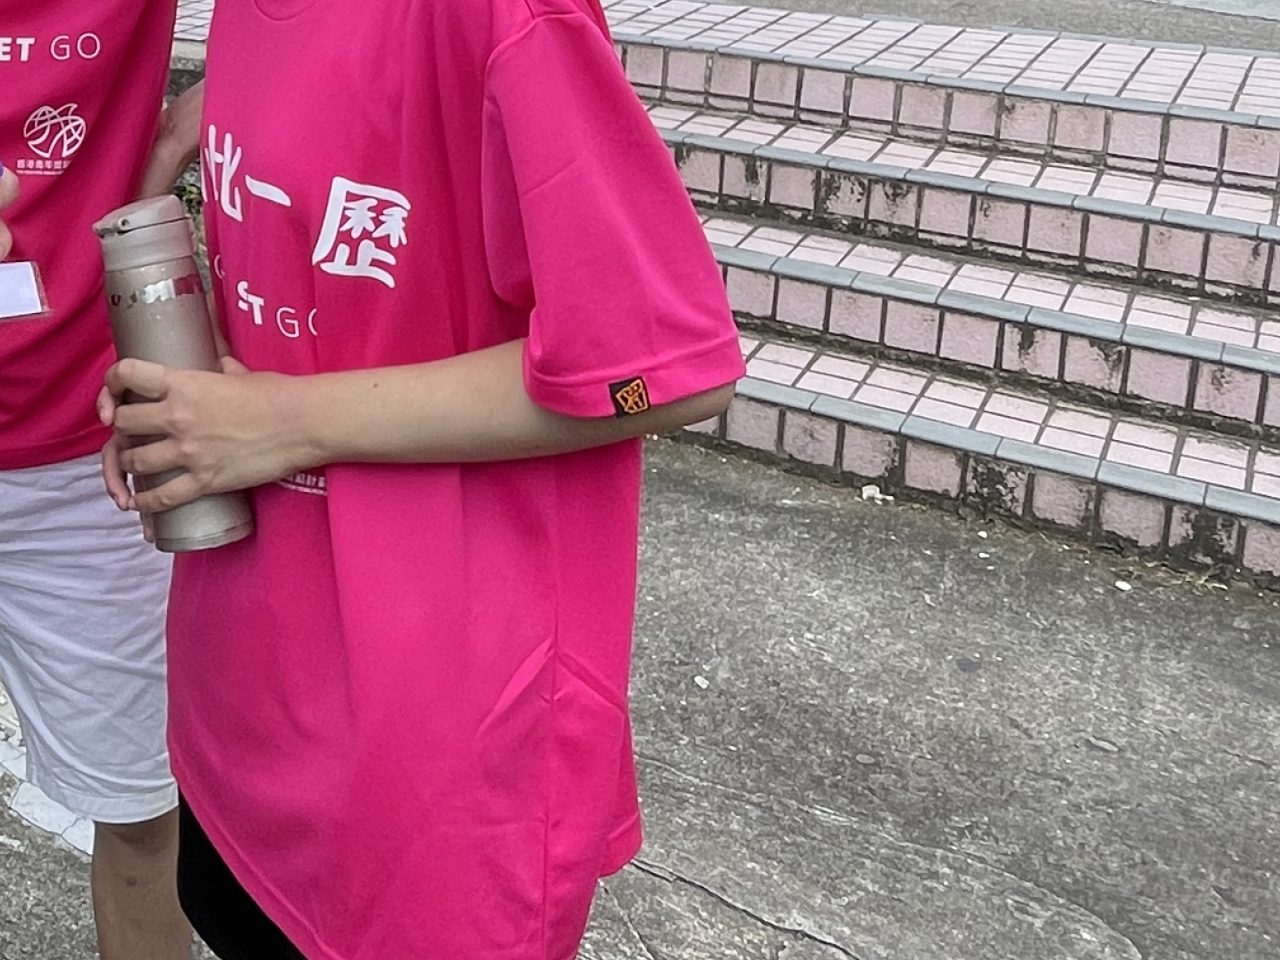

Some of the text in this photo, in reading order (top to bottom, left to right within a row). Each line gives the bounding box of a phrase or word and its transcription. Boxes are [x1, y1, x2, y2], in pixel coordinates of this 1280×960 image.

[49, 32, 101, 60] GO
[200, 123, 412, 289] 此一歷
